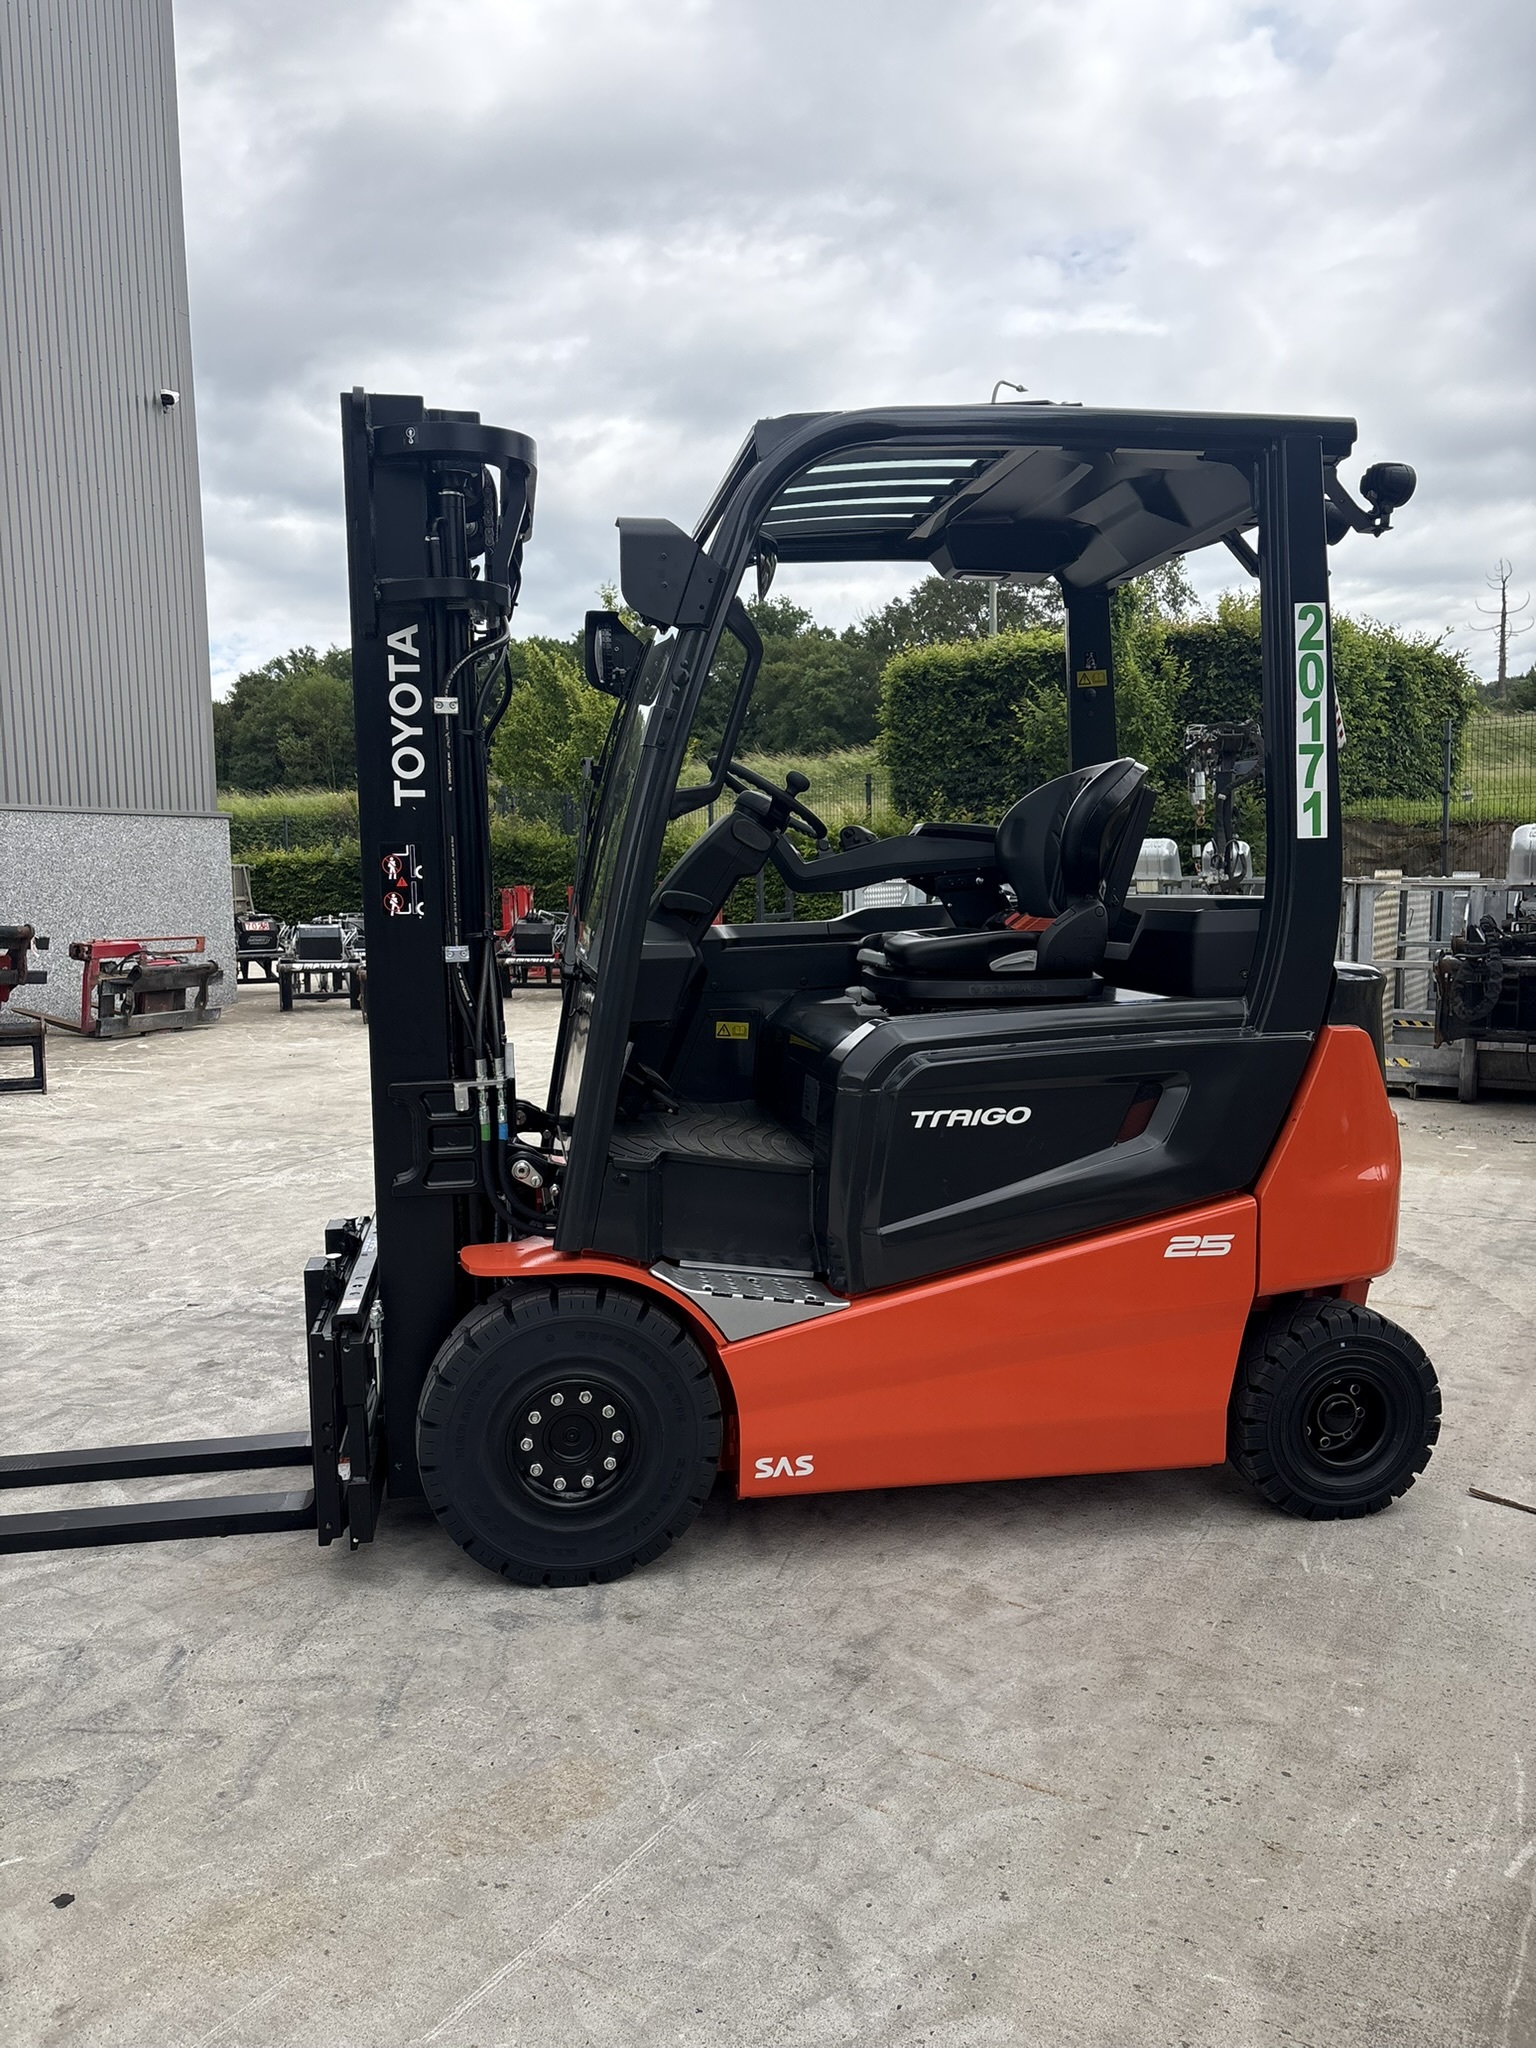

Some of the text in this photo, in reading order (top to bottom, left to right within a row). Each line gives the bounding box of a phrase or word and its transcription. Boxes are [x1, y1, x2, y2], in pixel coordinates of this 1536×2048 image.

[386, 624, 426, 807] TOYOTA
[1298, 604, 1324, 836] 20171
[911, 1106, 1032, 1129] TRAIGO
[1164, 1234, 1235, 1258] 25
[754, 1455, 814, 1479] SAS
